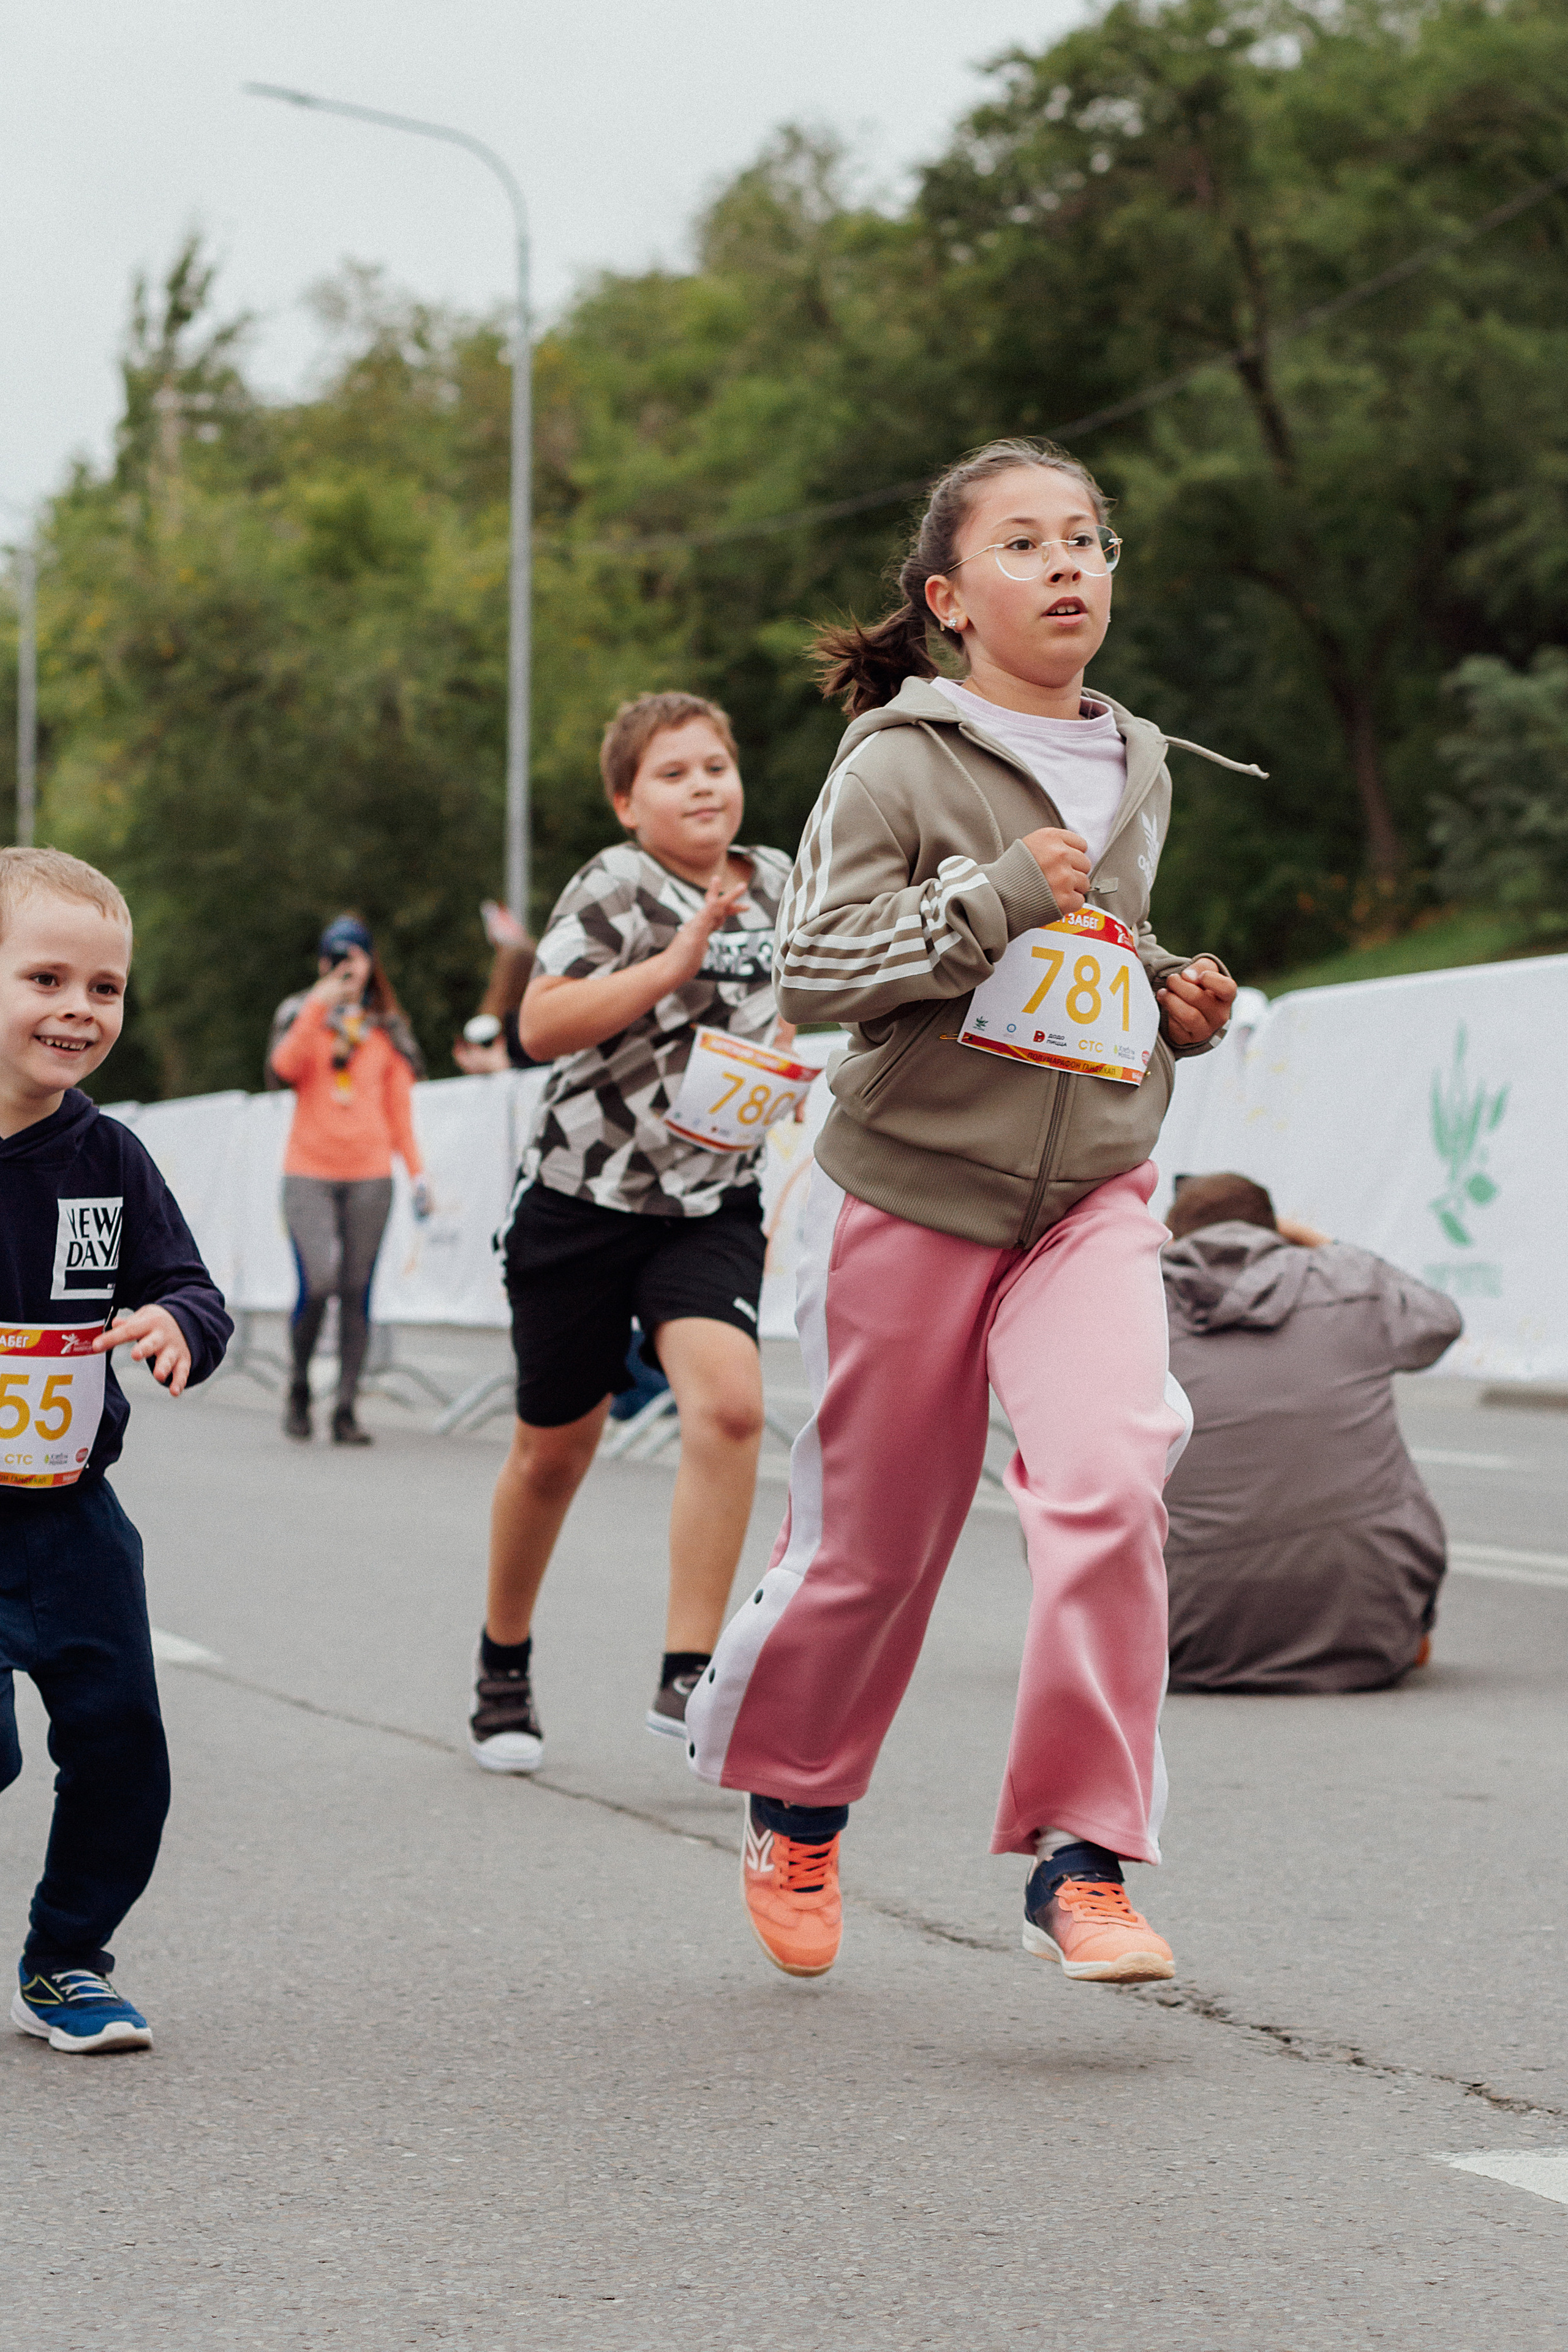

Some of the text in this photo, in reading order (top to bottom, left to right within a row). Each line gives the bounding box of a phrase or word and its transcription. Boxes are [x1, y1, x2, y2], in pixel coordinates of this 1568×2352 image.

[1068, 913, 1099, 930] ЗАБЕГ
[1021, 946, 1130, 1032] 781
[66, 1240, 113, 1267] DAY
